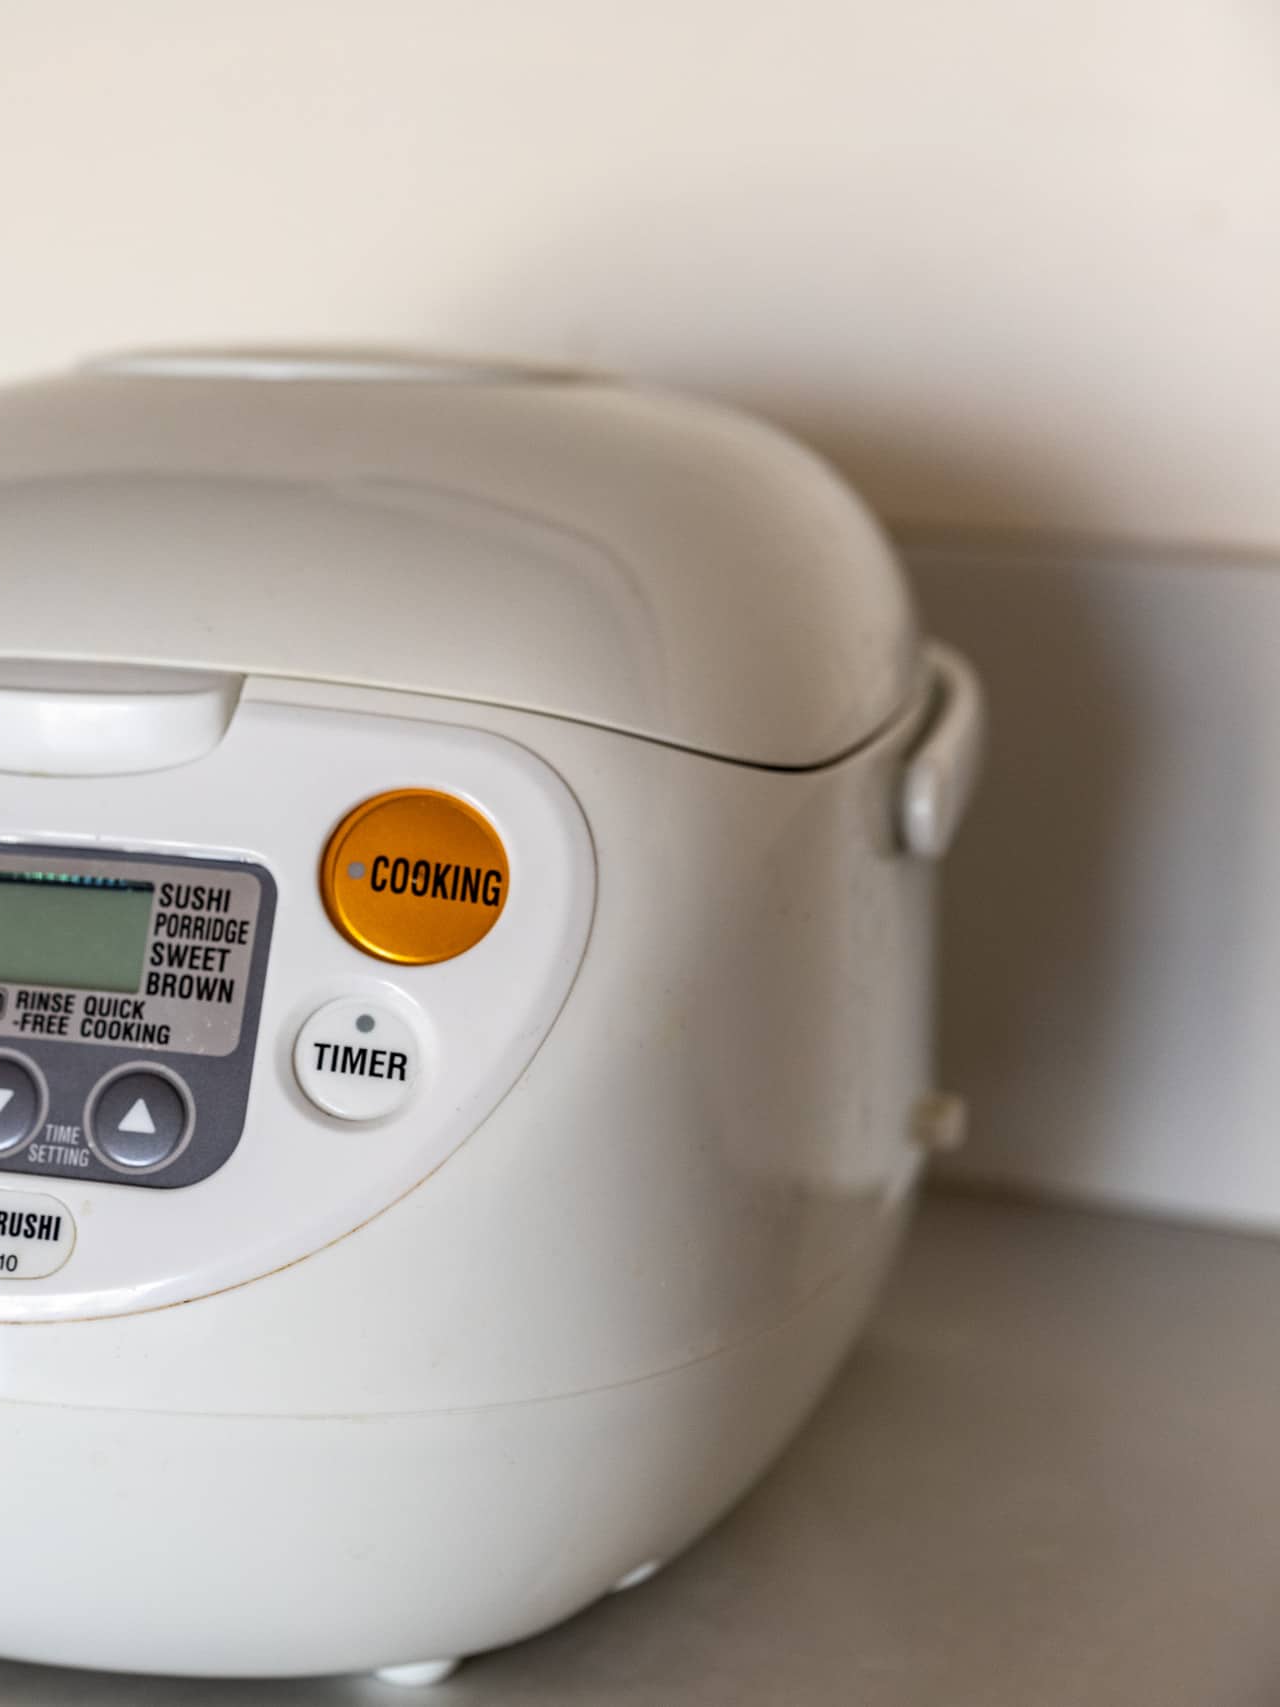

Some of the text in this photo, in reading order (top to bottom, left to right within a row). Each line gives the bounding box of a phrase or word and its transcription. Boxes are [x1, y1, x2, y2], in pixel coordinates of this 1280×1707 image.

[371, 855, 502, 907] COOKING
[159, 883, 231, 913] SUSHI
[153, 913, 249, 944] PORRIDGE
[149, 942, 231, 973] SWEET
[146, 972, 235, 1003] BROWN
[16, 990, 75, 1014] RINSE
[83, 995, 146, 1020] QUICK
[13, 1012, 70, 1035] -FREE
[80, 1018, 171, 1045] COOKING
[313, 1042, 408, 1082] TIMER
[45, 1124, 80, 1145] TIME
[28, 1143, 90, 1167] SETTING
